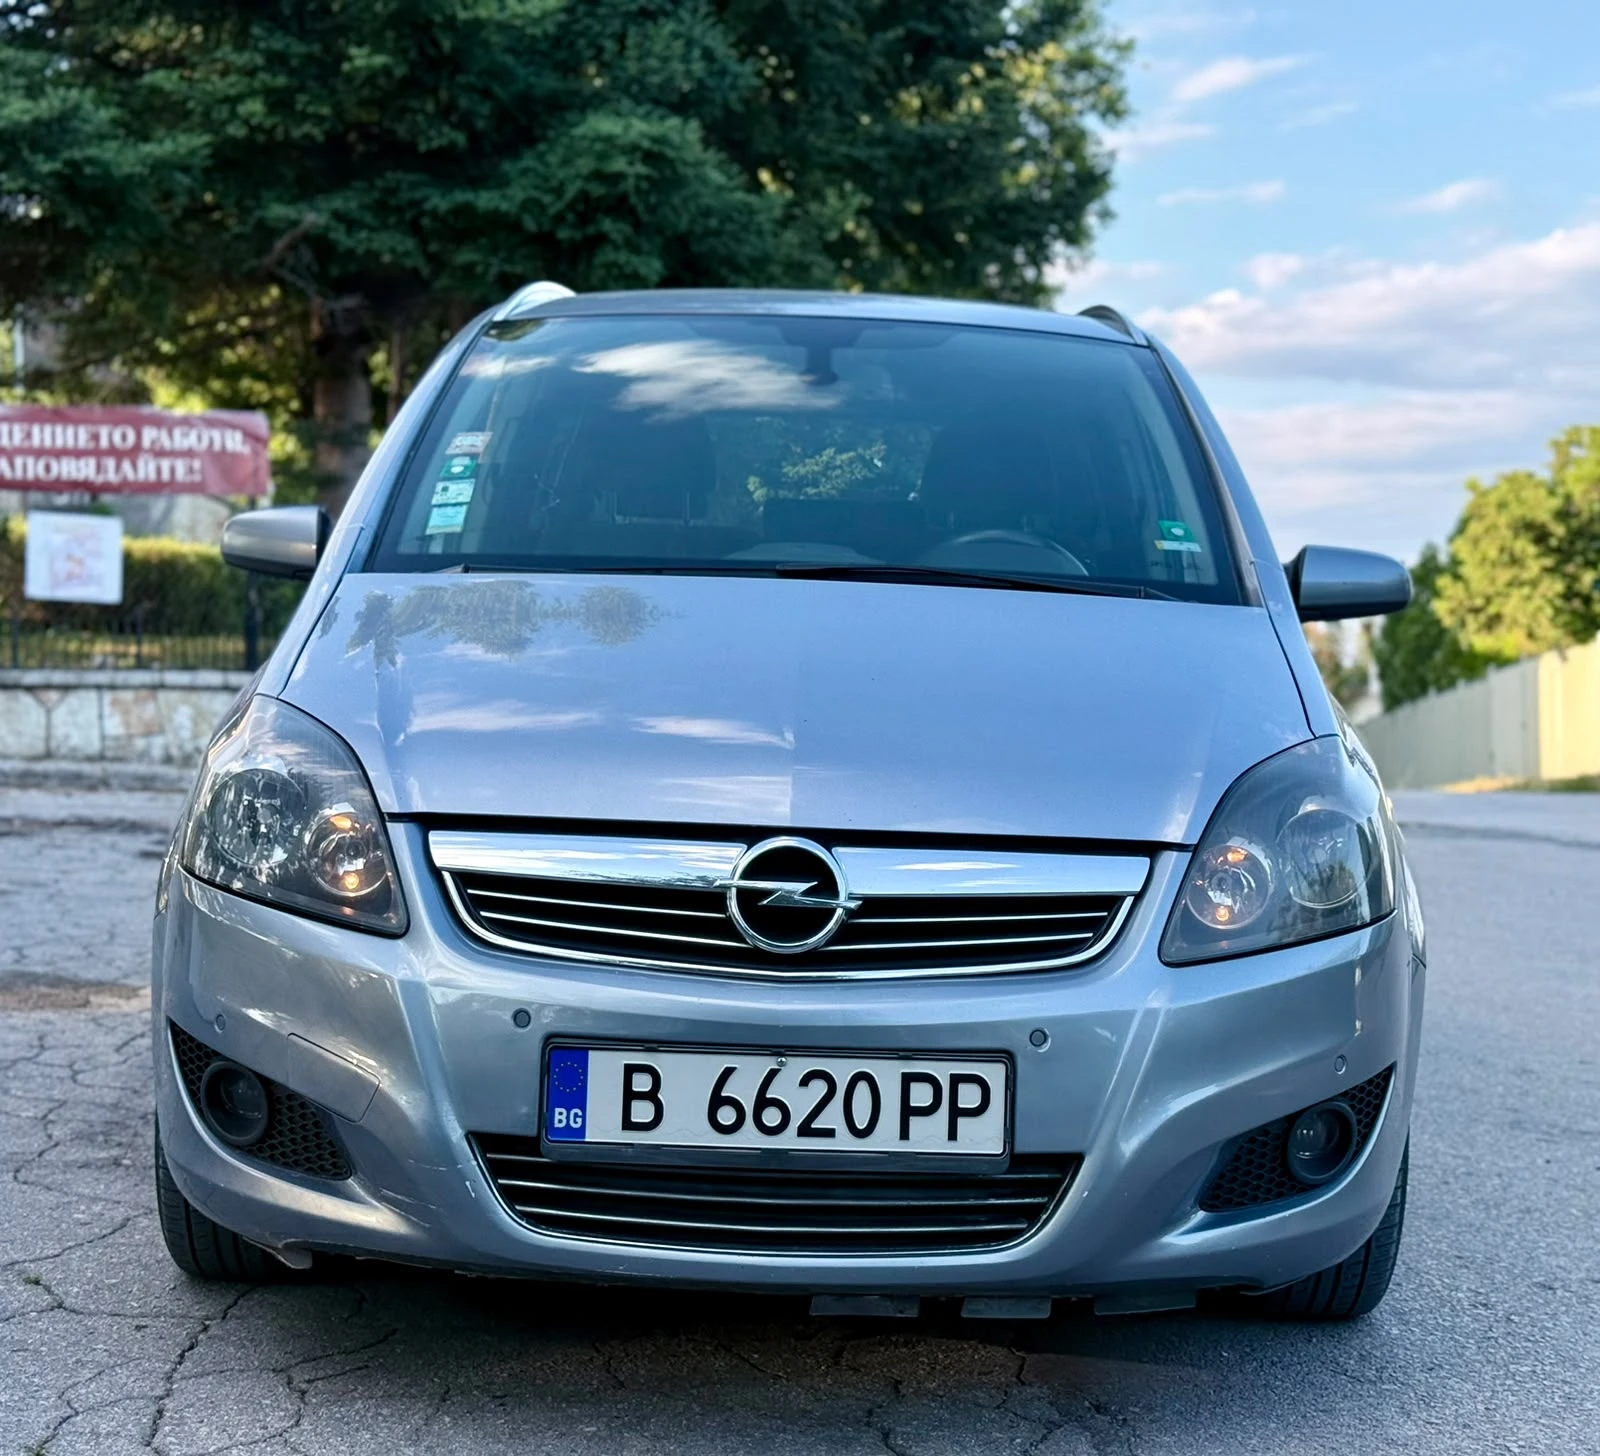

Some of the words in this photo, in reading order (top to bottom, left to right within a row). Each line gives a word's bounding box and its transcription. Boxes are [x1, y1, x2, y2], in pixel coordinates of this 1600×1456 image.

[554, 1107, 583, 1129] BG
[621, 1062, 665, 1132] B
[706, 1066, 882, 1139] 6620
[899, 1072, 991, 1141] PP
